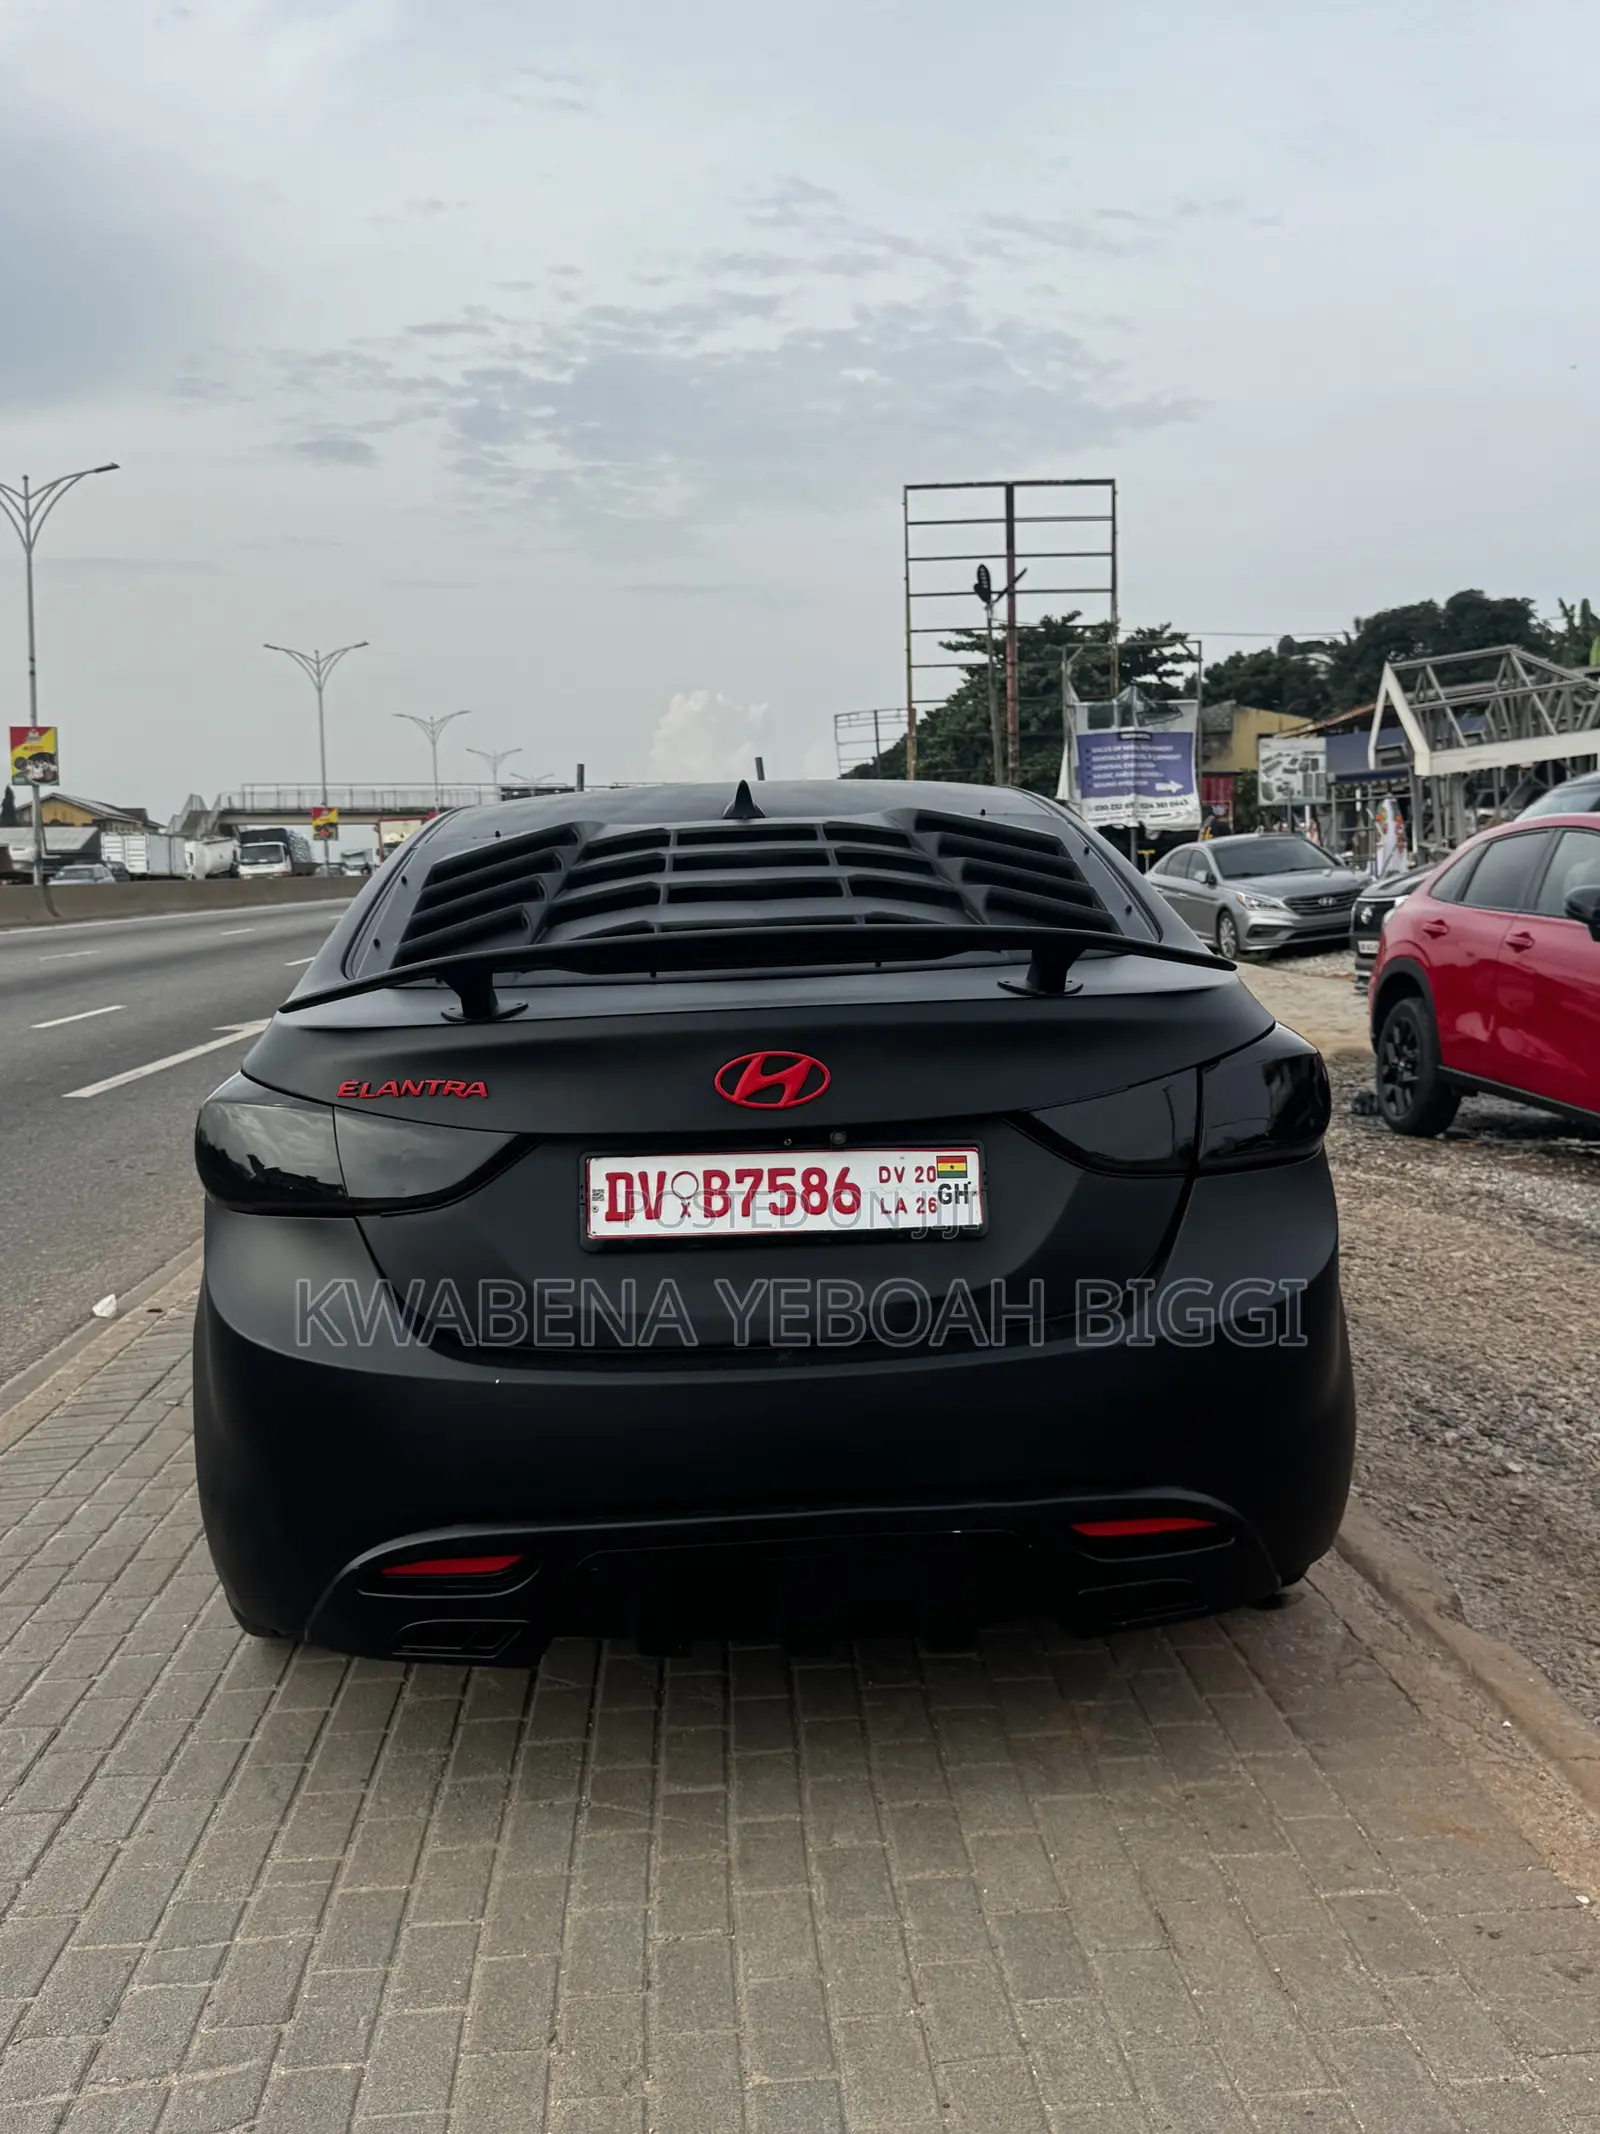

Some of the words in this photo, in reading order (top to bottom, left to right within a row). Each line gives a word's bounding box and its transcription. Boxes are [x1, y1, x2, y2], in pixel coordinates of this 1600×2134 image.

[337, 1079, 489, 1099] ELANTRA
[878, 1166, 905, 1184] DV
[914, 1165, 937, 1183] 20
[605, 1170, 667, 1222] DV
[702, 1166, 862, 1219] B7586
[937, 1183, 970, 1205] GH
[880, 1197, 908, 1215] LA
[915, 1196, 938, 1214] 26
